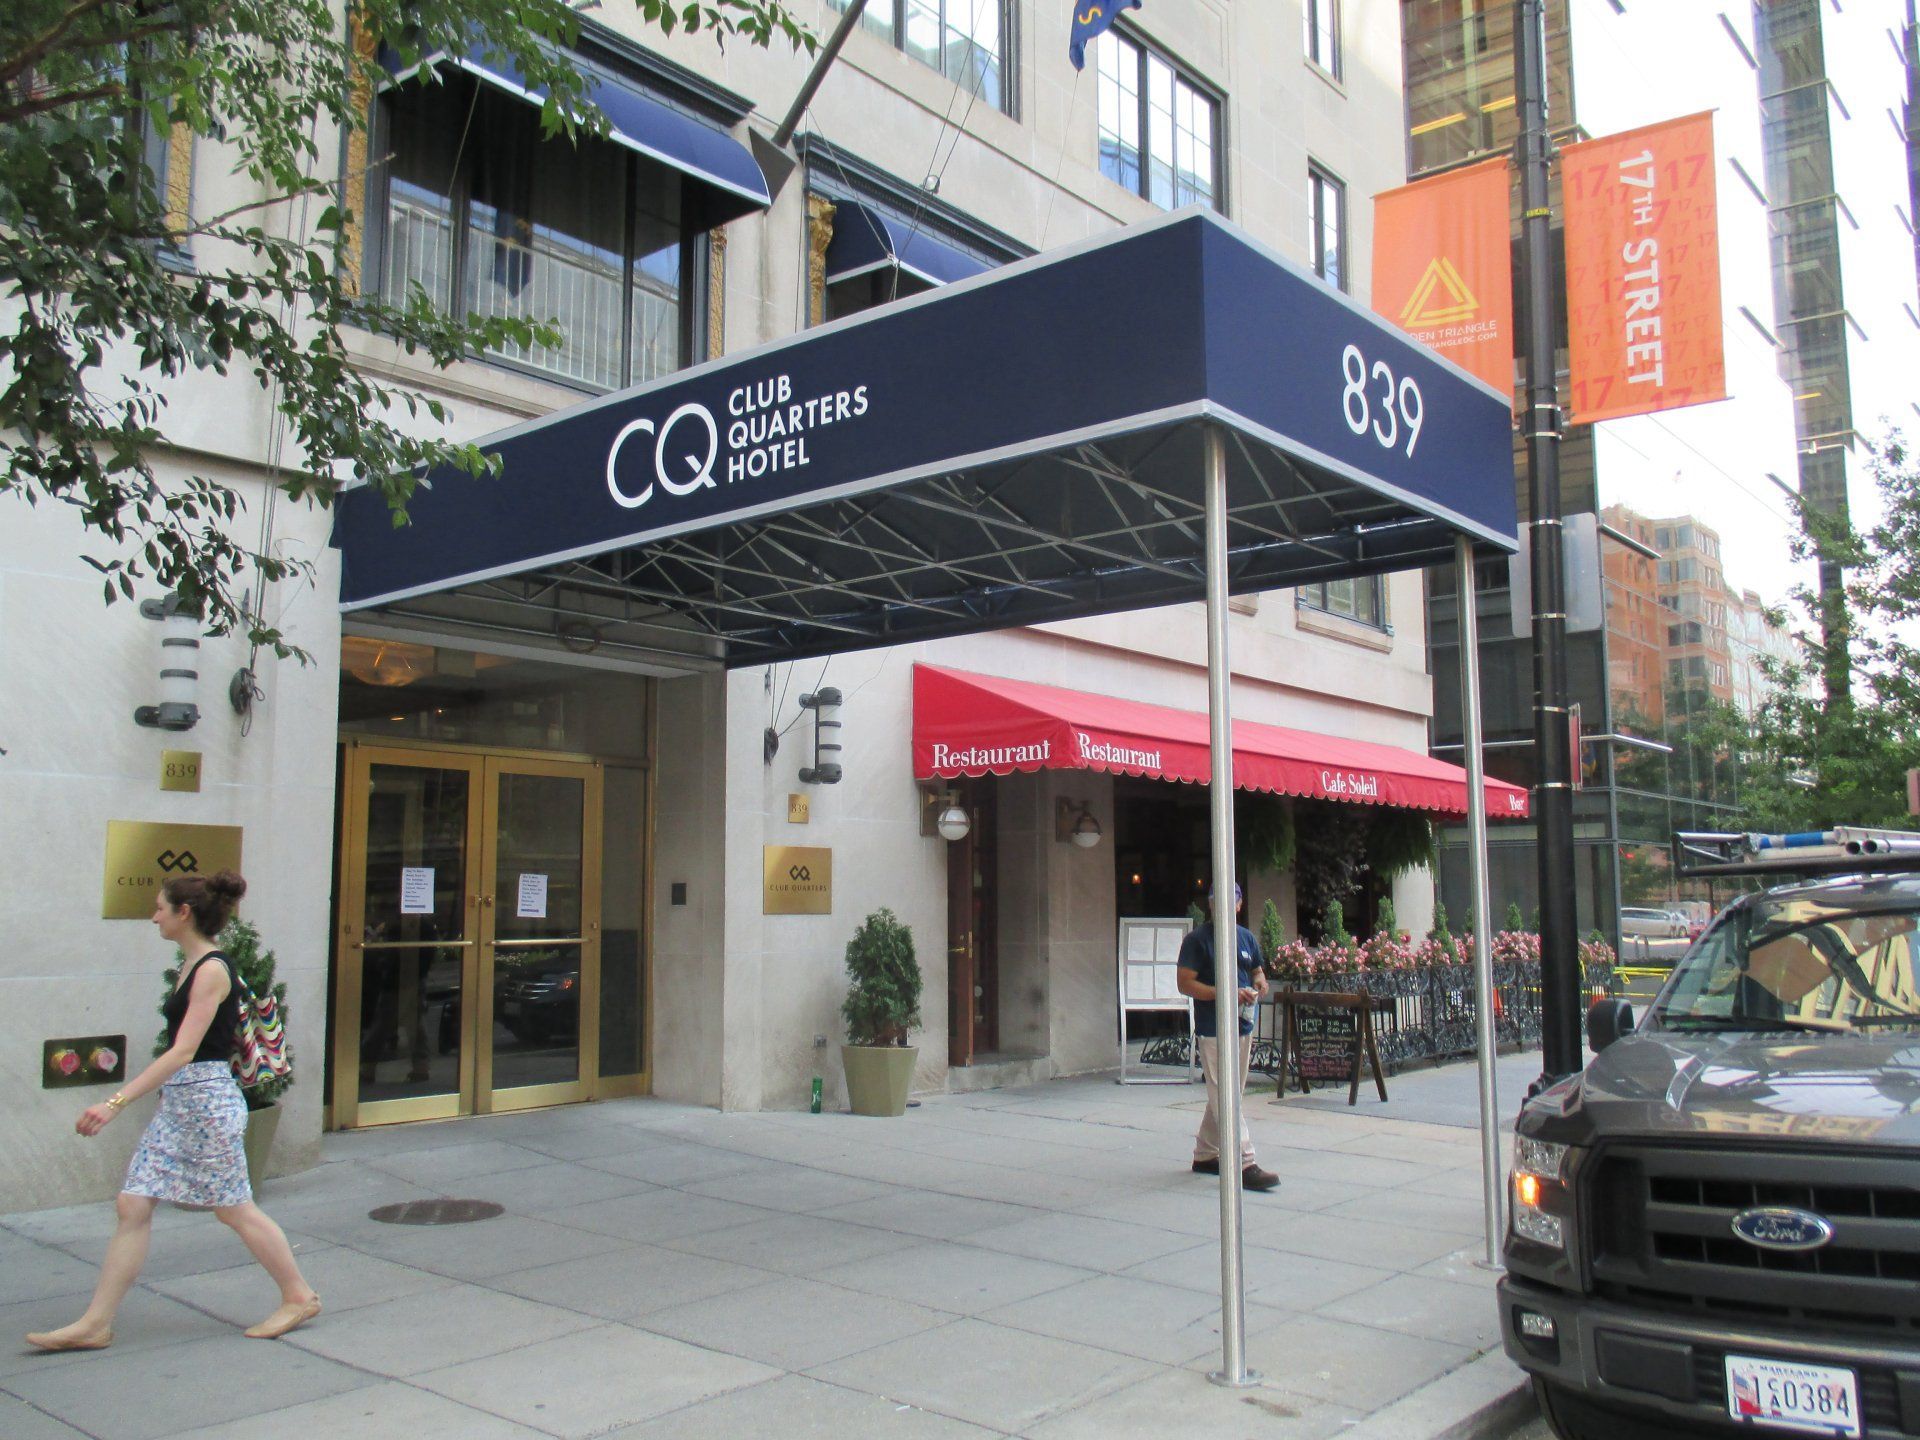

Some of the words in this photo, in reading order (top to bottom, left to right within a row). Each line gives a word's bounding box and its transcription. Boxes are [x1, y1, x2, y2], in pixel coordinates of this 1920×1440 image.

[1439, 320, 1497, 338] TRIANGLE
[1623, 238, 1664, 387] STREET
[728, 374, 792, 416] CLUB
[1342, 344, 1423, 459] 839
[728, 385, 869, 449] QUARTERS
[606, 402, 718, 509] CQ
[728, 437, 810, 483] HOTEL
[165, 762, 198, 778] 839
[931, 739, 1051, 768] Restaurant
[1077, 732, 1162, 769] Restaurant
[1321, 771, 1347, 794] Cafe
[1348, 773, 1378, 797] Soleil
[117, 876, 154, 887] CLUB
